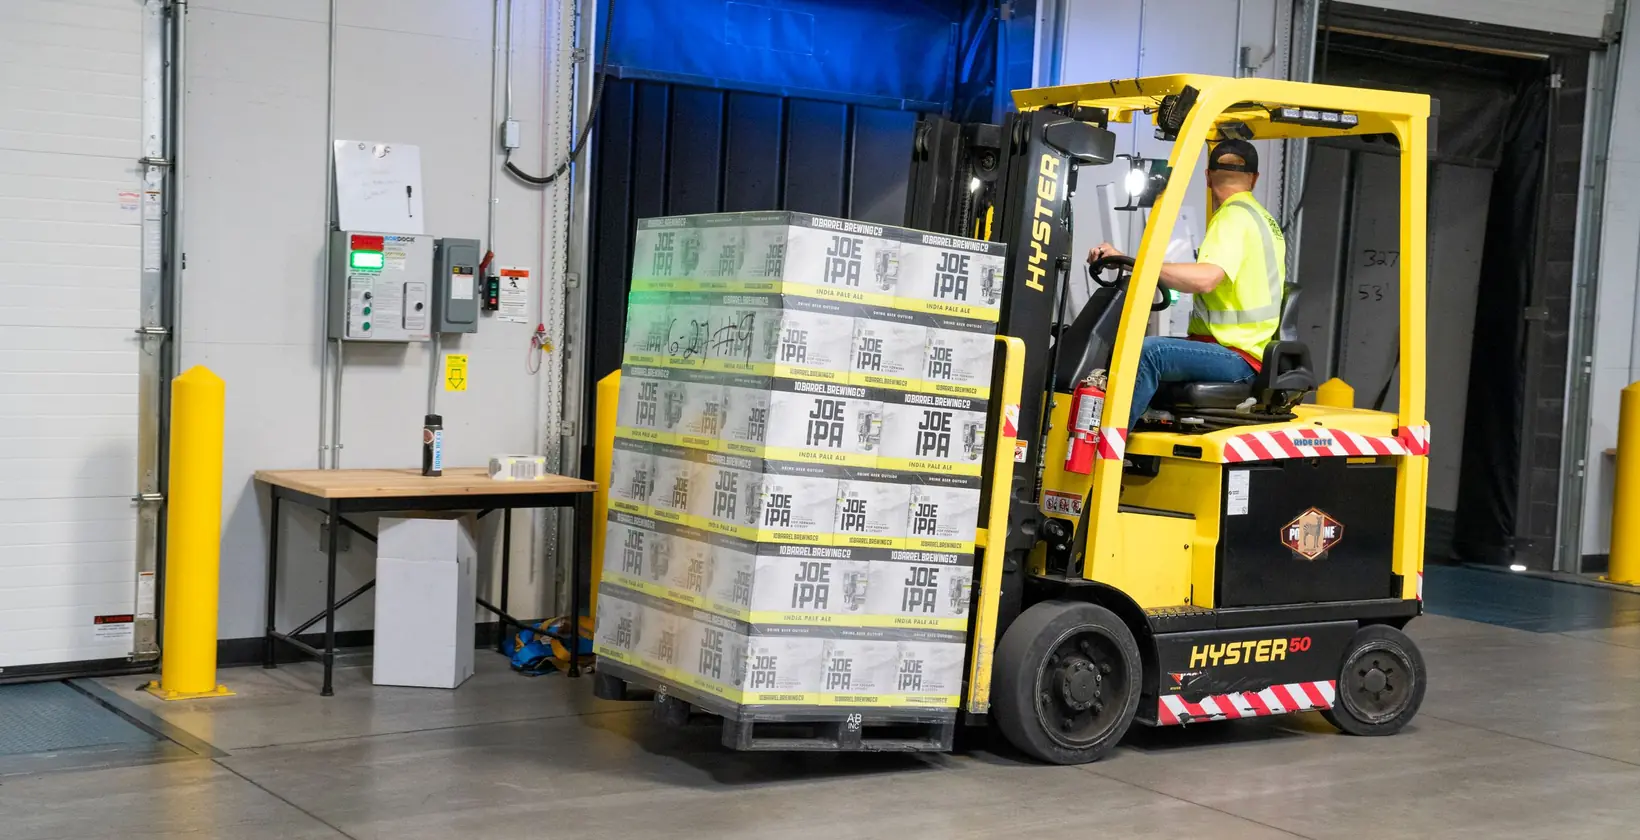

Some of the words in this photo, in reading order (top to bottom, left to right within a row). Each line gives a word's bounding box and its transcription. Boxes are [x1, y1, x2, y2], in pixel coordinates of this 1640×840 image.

[1026, 153, 1059, 292] HYSTER
[654, 232, 675, 251] JOE
[766, 244, 784, 258] JOE
[826, 235, 863, 260] JOE
[652, 252, 674, 276] IPA
[936, 252, 970, 275] JOE
[1364, 249, 1400, 267] 327
[764, 260, 781, 276] IPA
[823, 256, 861, 287] IPA
[933, 272, 969, 301] IPA
[783, 328, 808, 345] JOE
[859, 337, 883, 354] JOE
[781, 343, 807, 364] IPA
[856, 351, 881, 372] IPA
[930, 347, 953, 362] JOE
[928, 361, 951, 380] IPA
[638, 382, 658, 401] JOE
[636, 401, 656, 426] IPA
[703, 402, 719, 416] JOE
[749, 408, 766, 423] JOE
[809, 399, 846, 421] JOE
[701, 417, 718, 435] IPA
[918, 410, 952, 432] JOE
[747, 423, 764, 442] IPA
[806, 420, 844, 448] IPA
[916, 431, 951, 458] IPA
[632, 470, 647, 484] JOE
[673, 478, 688, 492] JOE
[715, 470, 738, 493] JOE
[632, 484, 646, 501] IPA
[672, 492, 687, 510] IPA
[767, 493, 792, 509] JOE
[713, 492, 737, 520] IPA
[842, 498, 867, 514] JOE
[915, 503, 938, 518] JOE
[765, 508, 791, 527] IPA
[841, 514, 866, 532] IPA
[913, 518, 936, 535] IPA
[625, 528, 644, 551] JOE
[622, 548, 643, 576] IPA
[795, 561, 832, 583] JOE
[905, 566, 939, 587] JOE
[791, 583, 829, 610] IPA
[902, 587, 938, 613] IPA
[701, 628, 724, 652] JOE
[1190, 638, 1287, 668] HYSTER
[1289, 636, 1311, 652] 50
[699, 650, 722, 679] IPA
[752, 656, 777, 670] JOE
[828, 658, 852, 672] JOE
[900, 660, 923, 673] JOE
[750, 671, 776, 689] IPA
[826, 673, 851, 690] IPA
[898, 673, 921, 691] IPA
